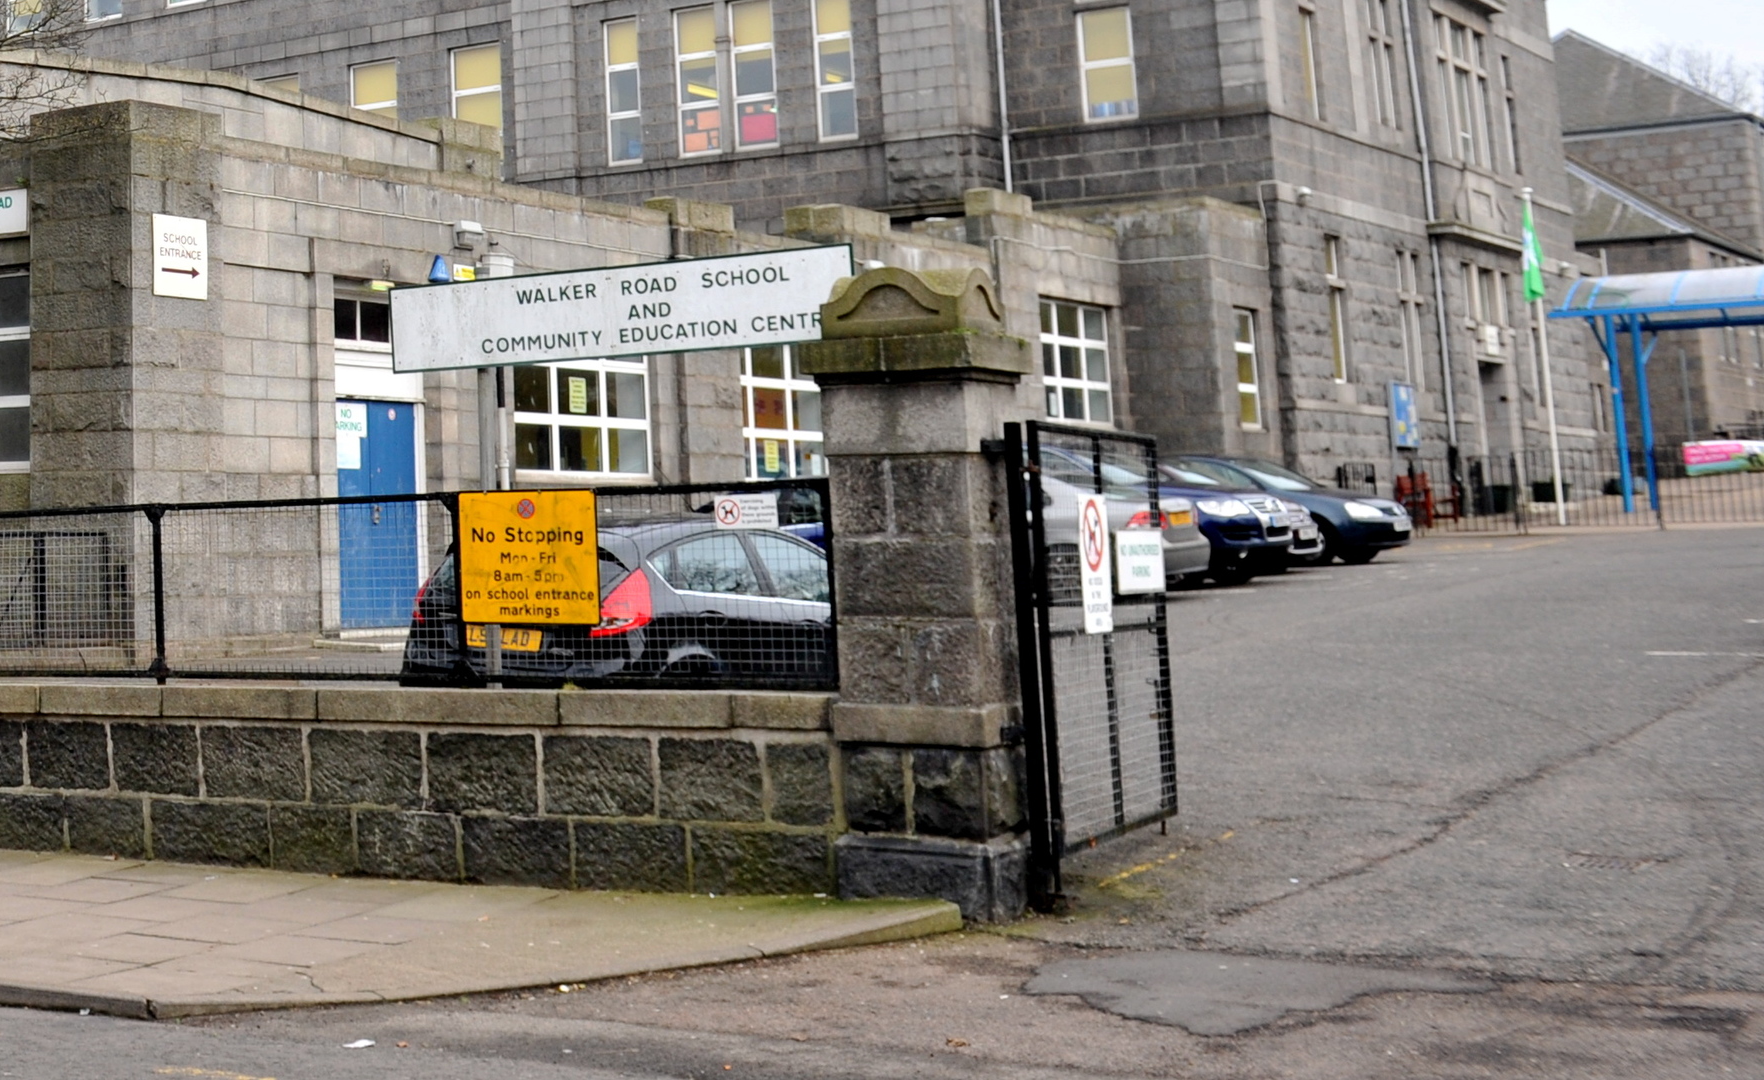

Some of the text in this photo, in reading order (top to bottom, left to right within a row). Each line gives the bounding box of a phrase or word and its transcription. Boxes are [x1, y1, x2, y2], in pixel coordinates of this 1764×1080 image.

[163, 232, 198, 246] SCHOOL
[159, 246, 202, 261] ENTRANCE
[516, 265, 791, 306] WALKER ROAD SCHOOL
[627, 301, 672, 321] AND
[481, 312, 822, 355] COMMUNITY EDUCATION CENTR
[340, 408, 352, 419] NO
[336, 420, 362, 431] ARKING
[471, 526, 584, 546] No Stopping
[539, 552, 556, 564] Fri
[465, 588, 594, 601] on school entrance
[499, 604, 560, 619] markings
